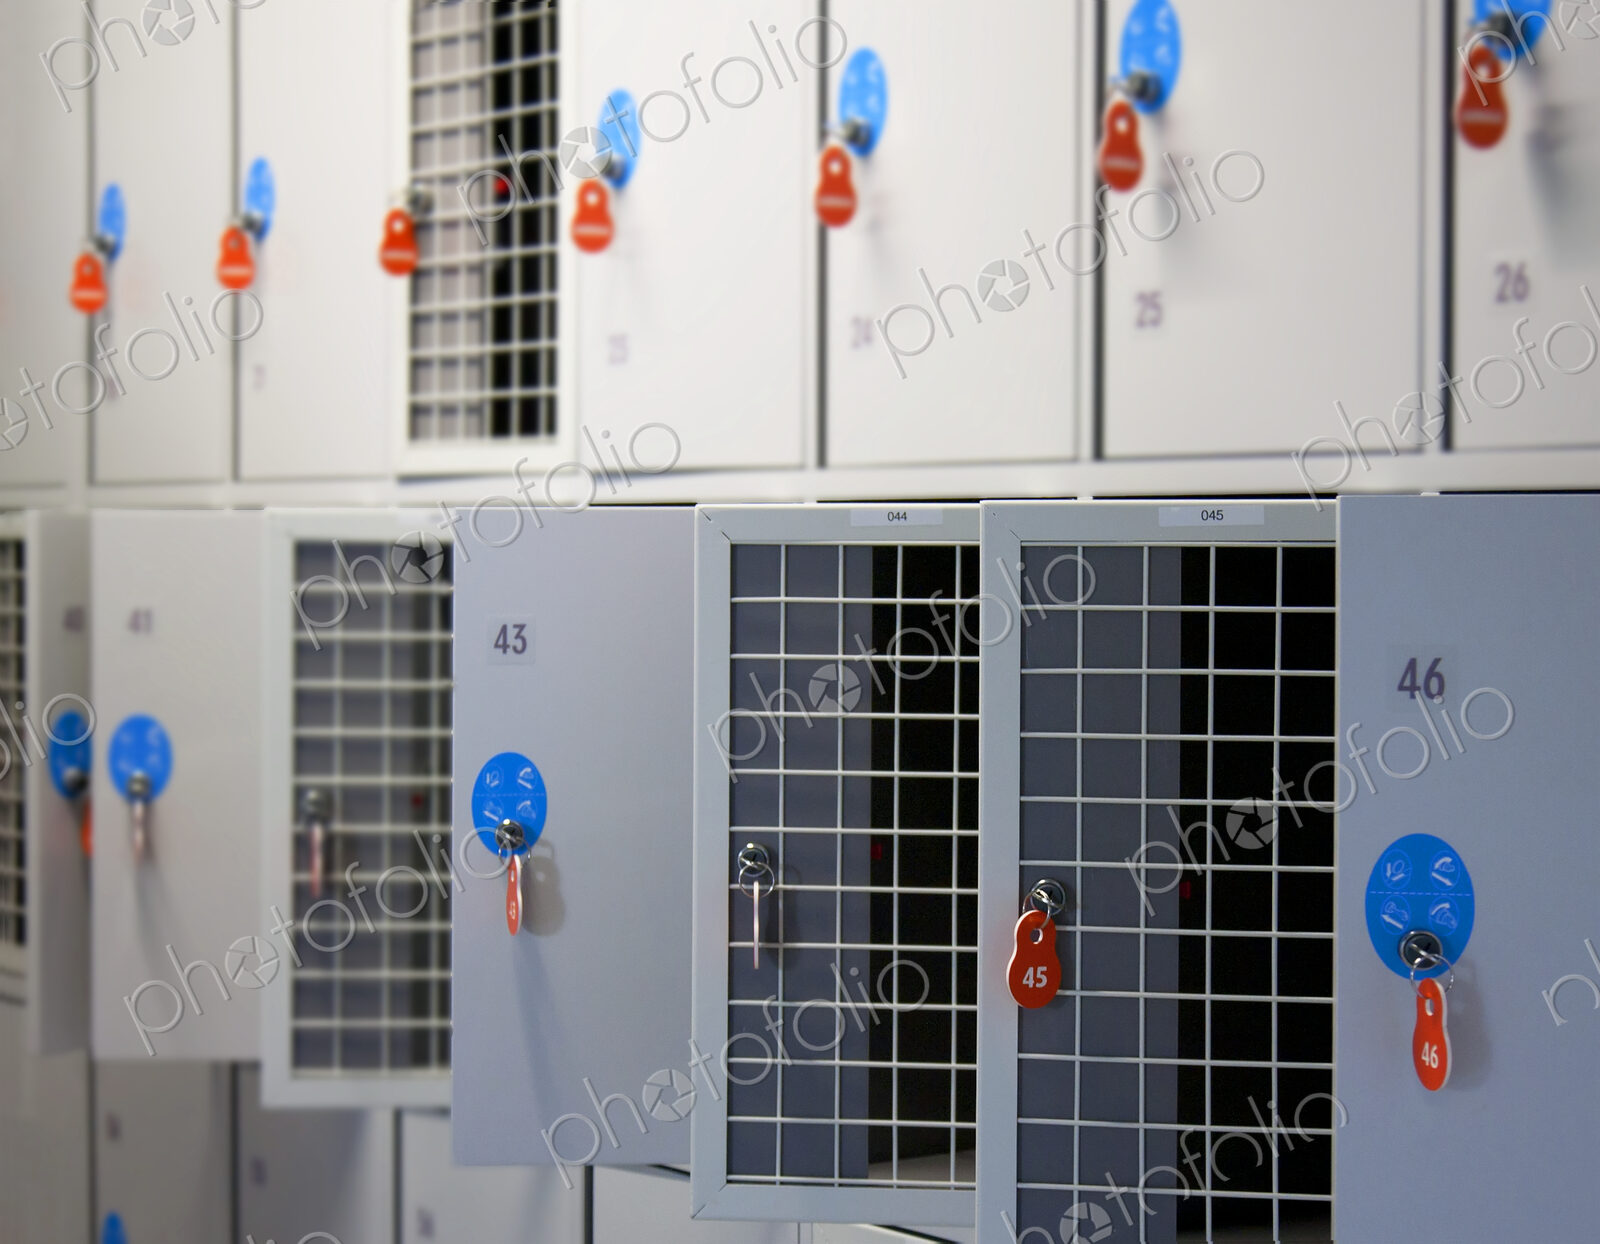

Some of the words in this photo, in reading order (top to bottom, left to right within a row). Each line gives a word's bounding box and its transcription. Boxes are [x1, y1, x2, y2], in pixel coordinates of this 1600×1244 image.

[1494, 262, 1529, 303] 26
[887, 511, 908, 522] 044
[1200, 510, 1224, 521] 045
[493, 624, 527, 655] 43
[1397, 657, 1446, 700] 46
[1022, 967, 1048, 987] 45
[1421, 1041, 1440, 1069] 46
